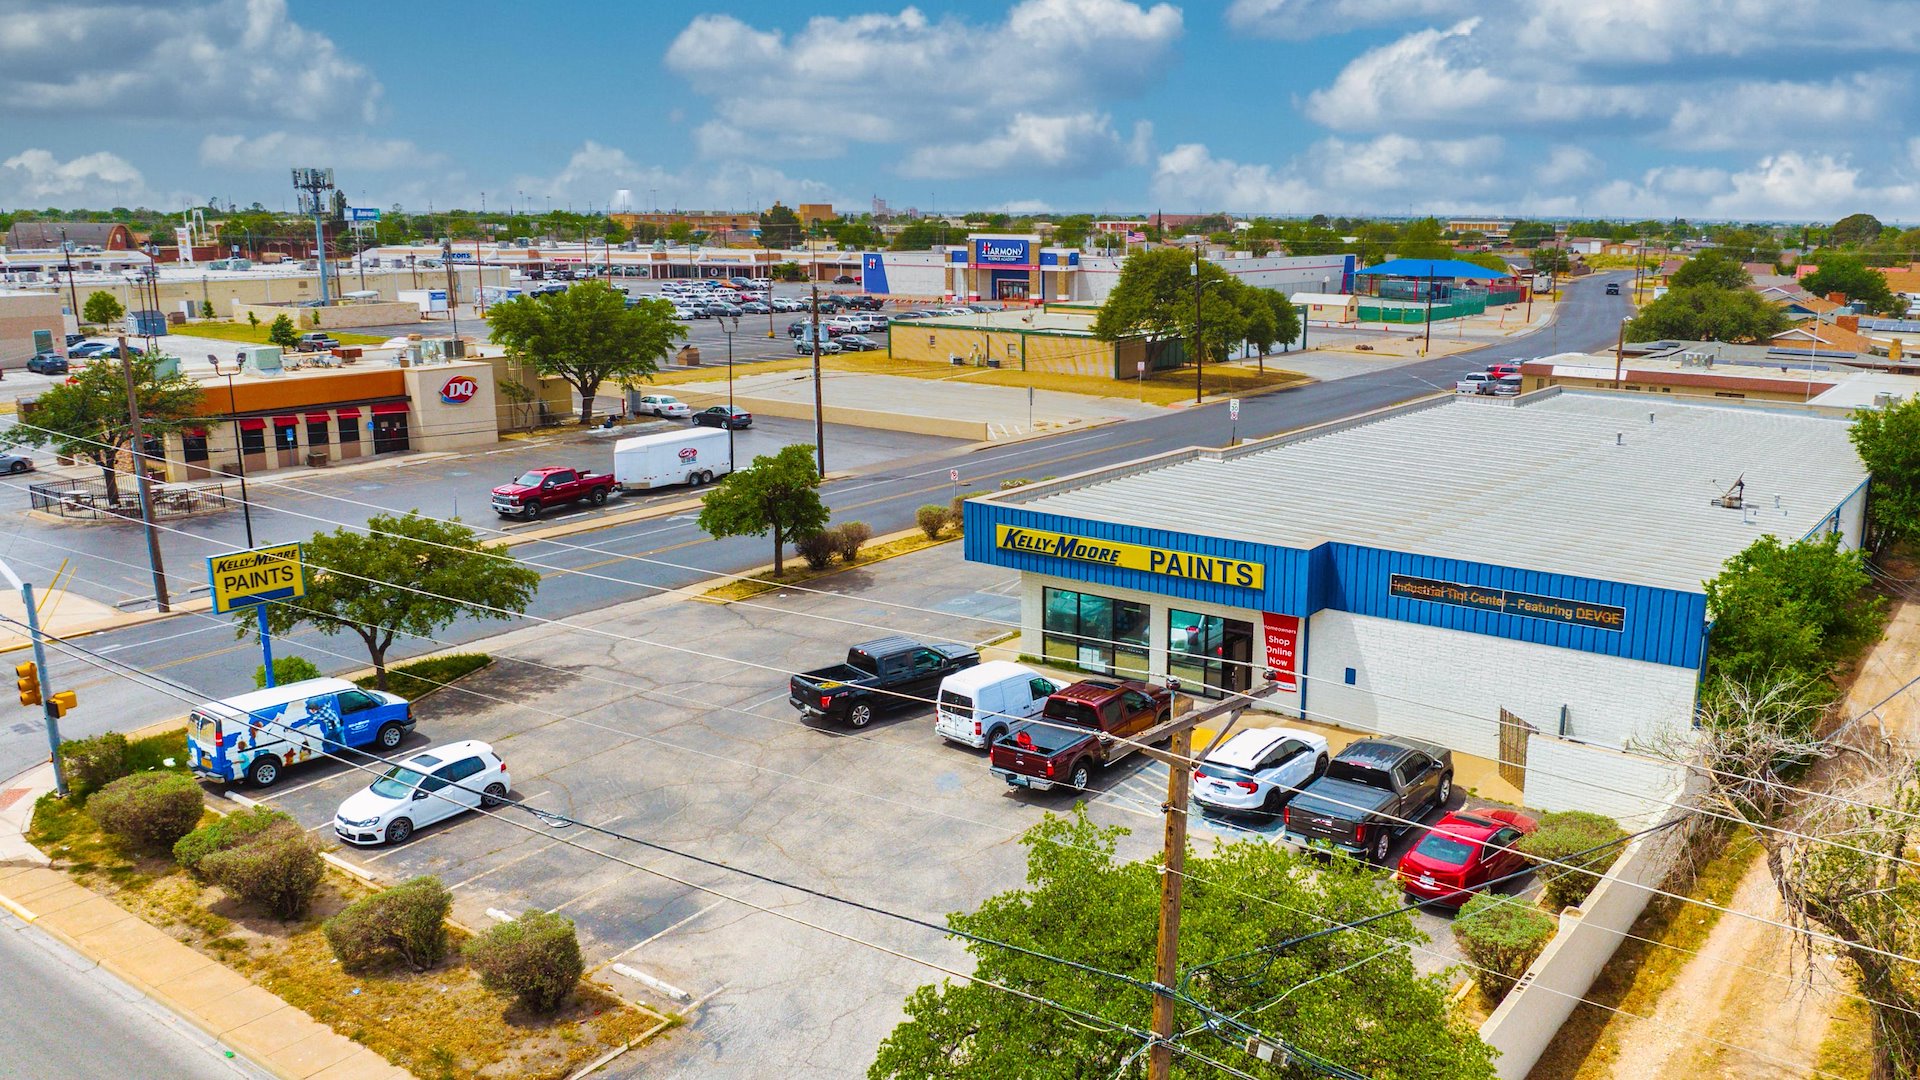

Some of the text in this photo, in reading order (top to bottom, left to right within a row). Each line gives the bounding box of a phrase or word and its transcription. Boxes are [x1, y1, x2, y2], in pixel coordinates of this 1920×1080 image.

[982, 242, 1023, 256] HARMONY
[449, 381, 474, 397] DQ
[216, 549, 297, 573] KELLY-MOORE
[1003, 528, 1253, 587] KELLY-MOORE PAINTS
[224, 566, 294, 593] PAINTS
[1470, 592, 1507, 607] Center
[1517, 599, 1573, 620] Featuring
[1268, 635, 1290, 646] Shop
[1266, 645, 1293, 657] Online
[1269, 657, 1288, 667] Now
